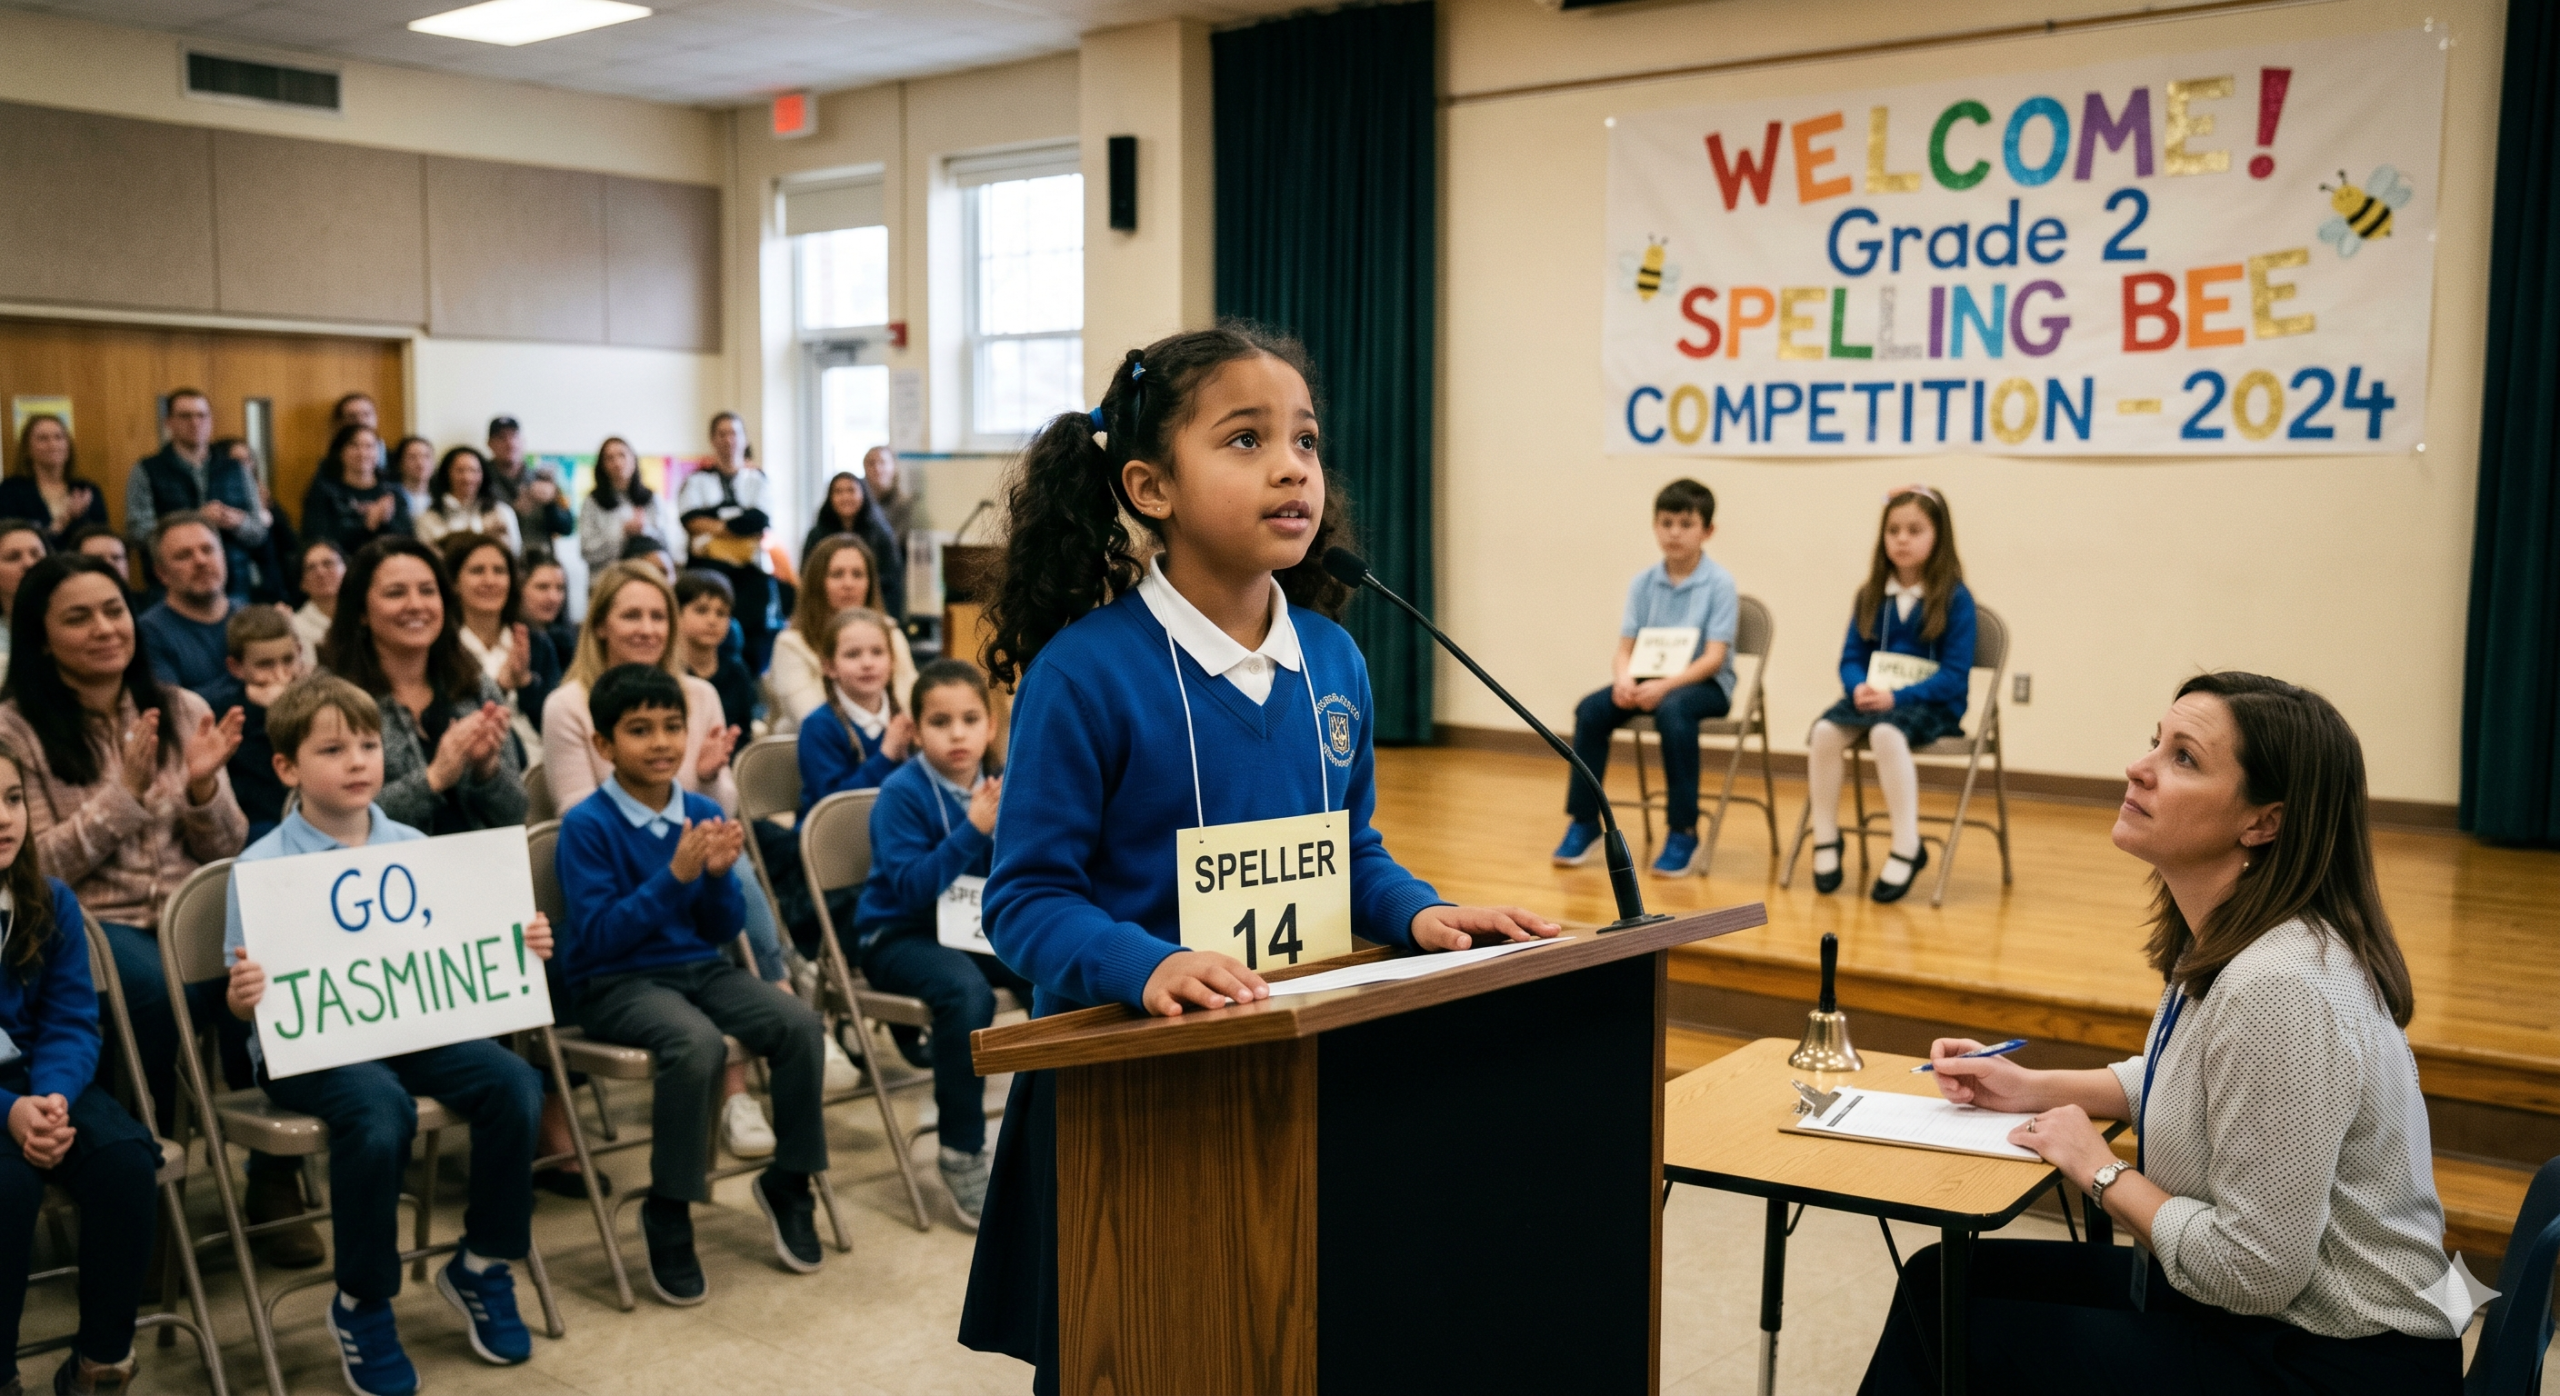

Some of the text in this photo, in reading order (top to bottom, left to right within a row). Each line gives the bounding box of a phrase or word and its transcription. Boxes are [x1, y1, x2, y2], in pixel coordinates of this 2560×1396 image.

[1705, 66, 2292, 211] WELCOME!
[1827, 188, 2149, 276] Grade 2
[1675, 247, 2316, 361] SPELLING BEE
[1626, 376, 2093, 444] COMPETITION
[2180, 366, 2396, 441] 2024
[330, 864, 432, 932] GO,
[1195, 839, 1336, 893] SPELLER
[1233, 902, 1303, 971] 14
[273, 923, 530, 1040] JASMINE!
